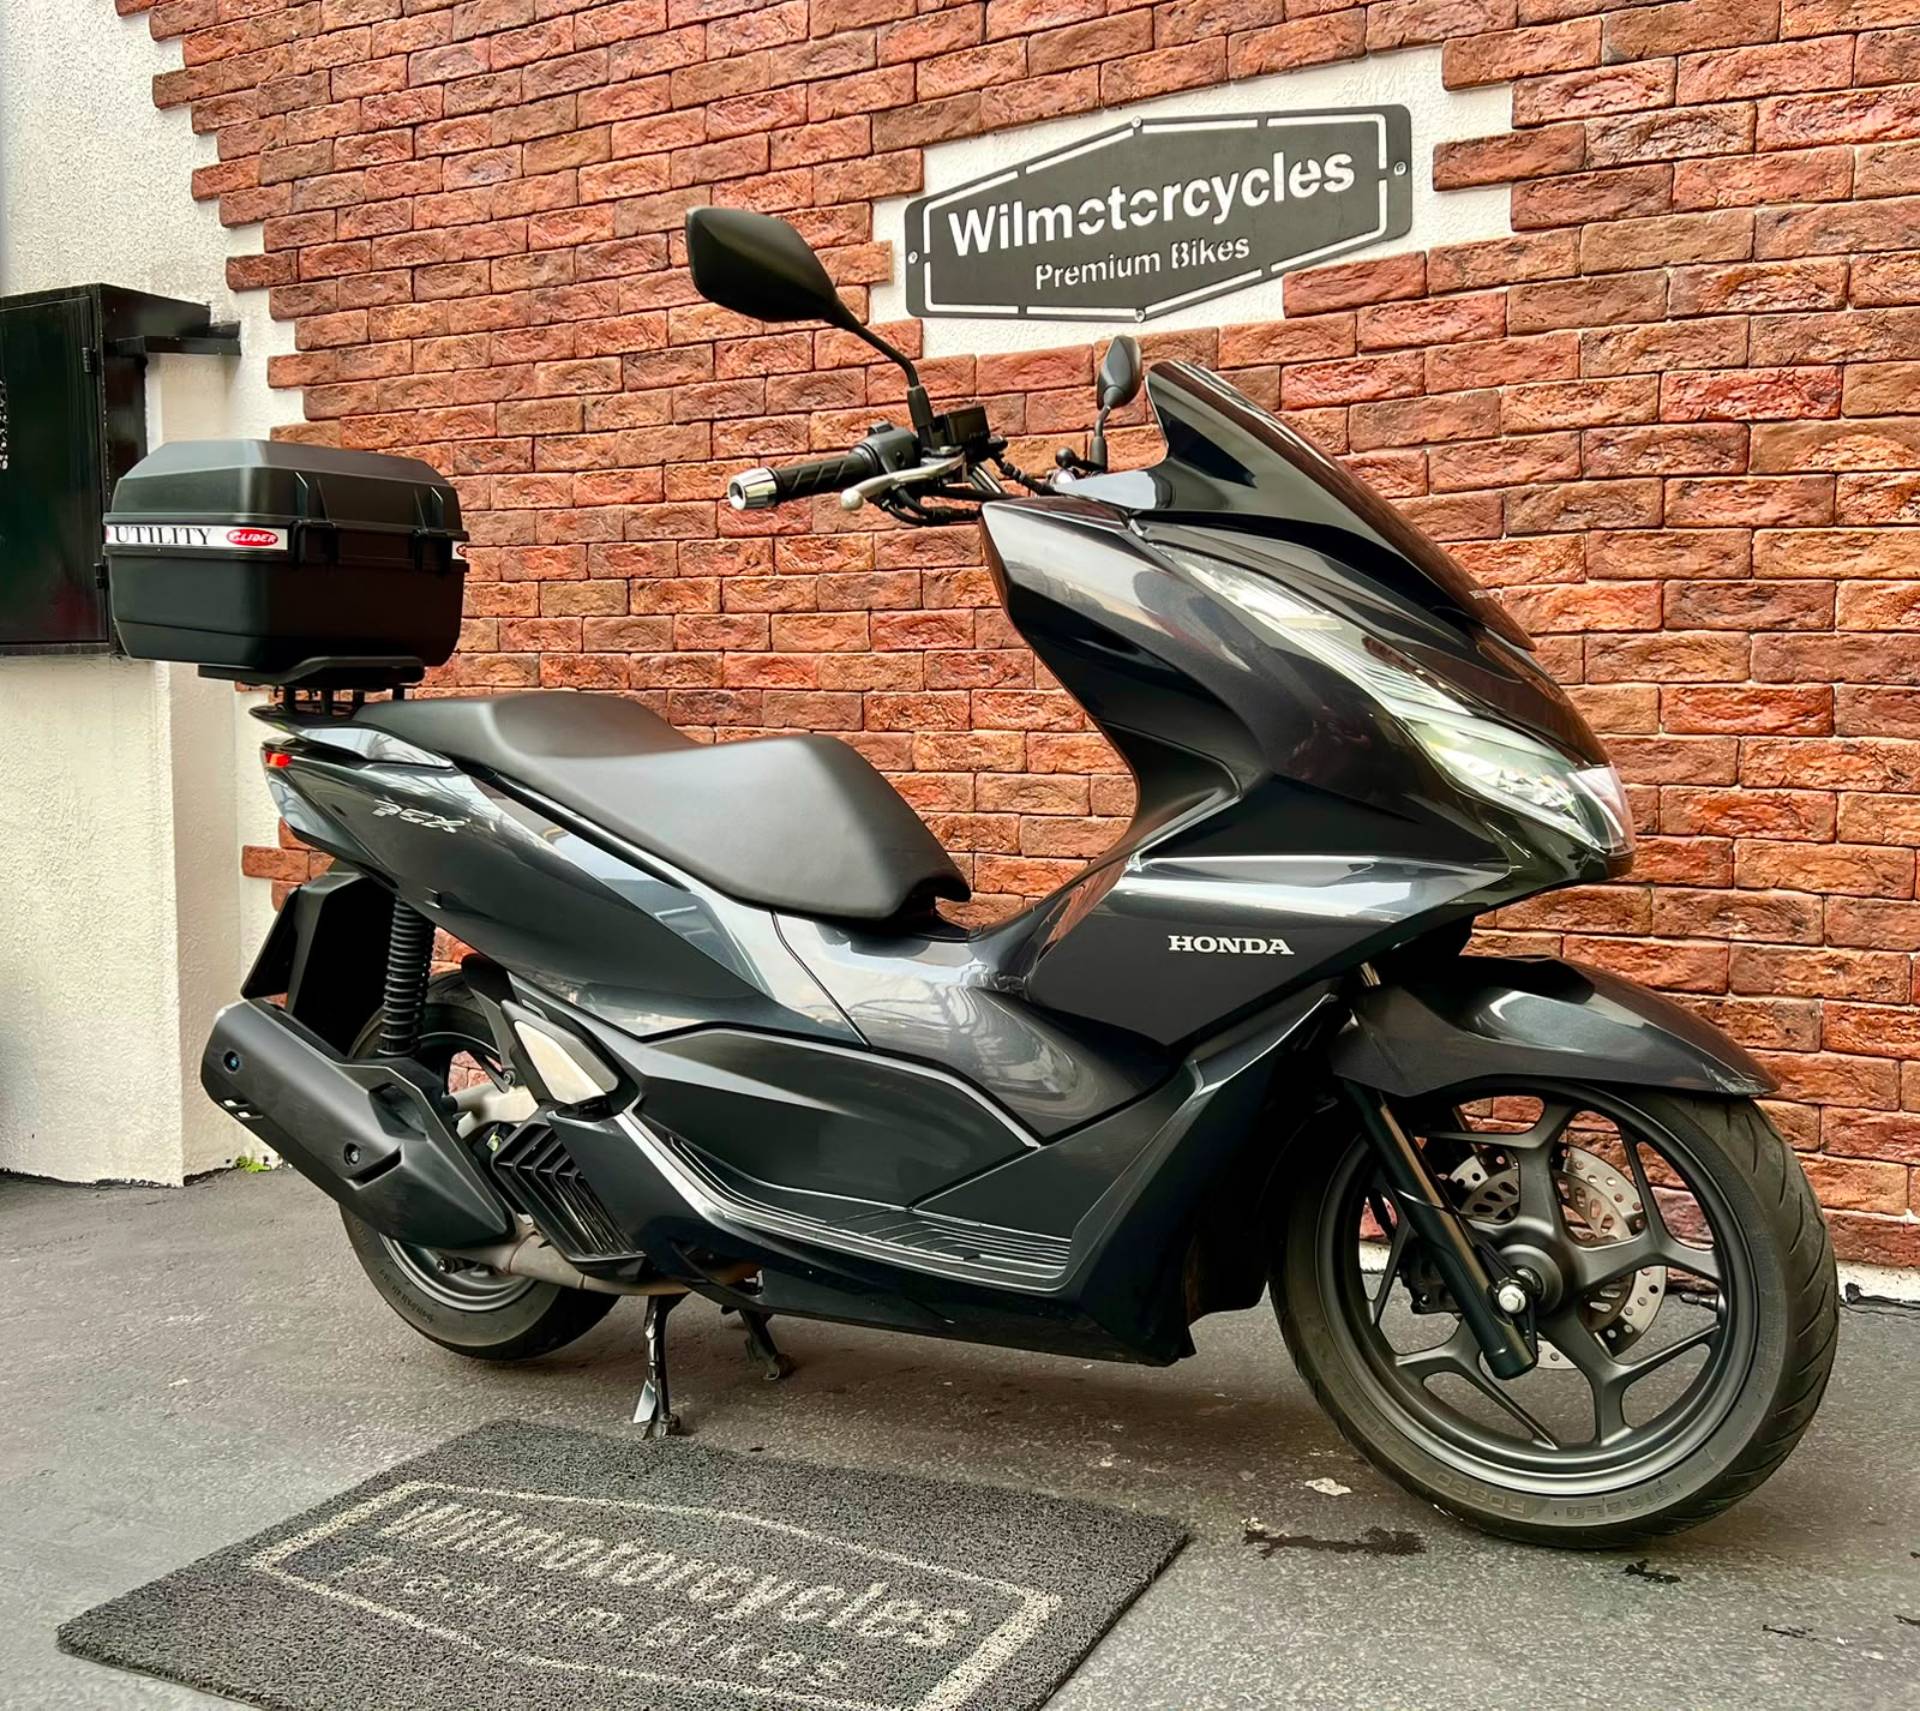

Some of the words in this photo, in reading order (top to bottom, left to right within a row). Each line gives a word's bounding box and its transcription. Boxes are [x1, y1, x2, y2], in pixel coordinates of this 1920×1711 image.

[948, 150, 1356, 257] Wilmotorcycles
[1035, 252, 1161, 290] Premium
[1171, 235, 1251, 270] Bikes
[114, 526, 212, 545] UTILITY
[1168, 935, 1296, 955] HONDA
[380, 1498, 974, 1646] Wilmotorcycles
